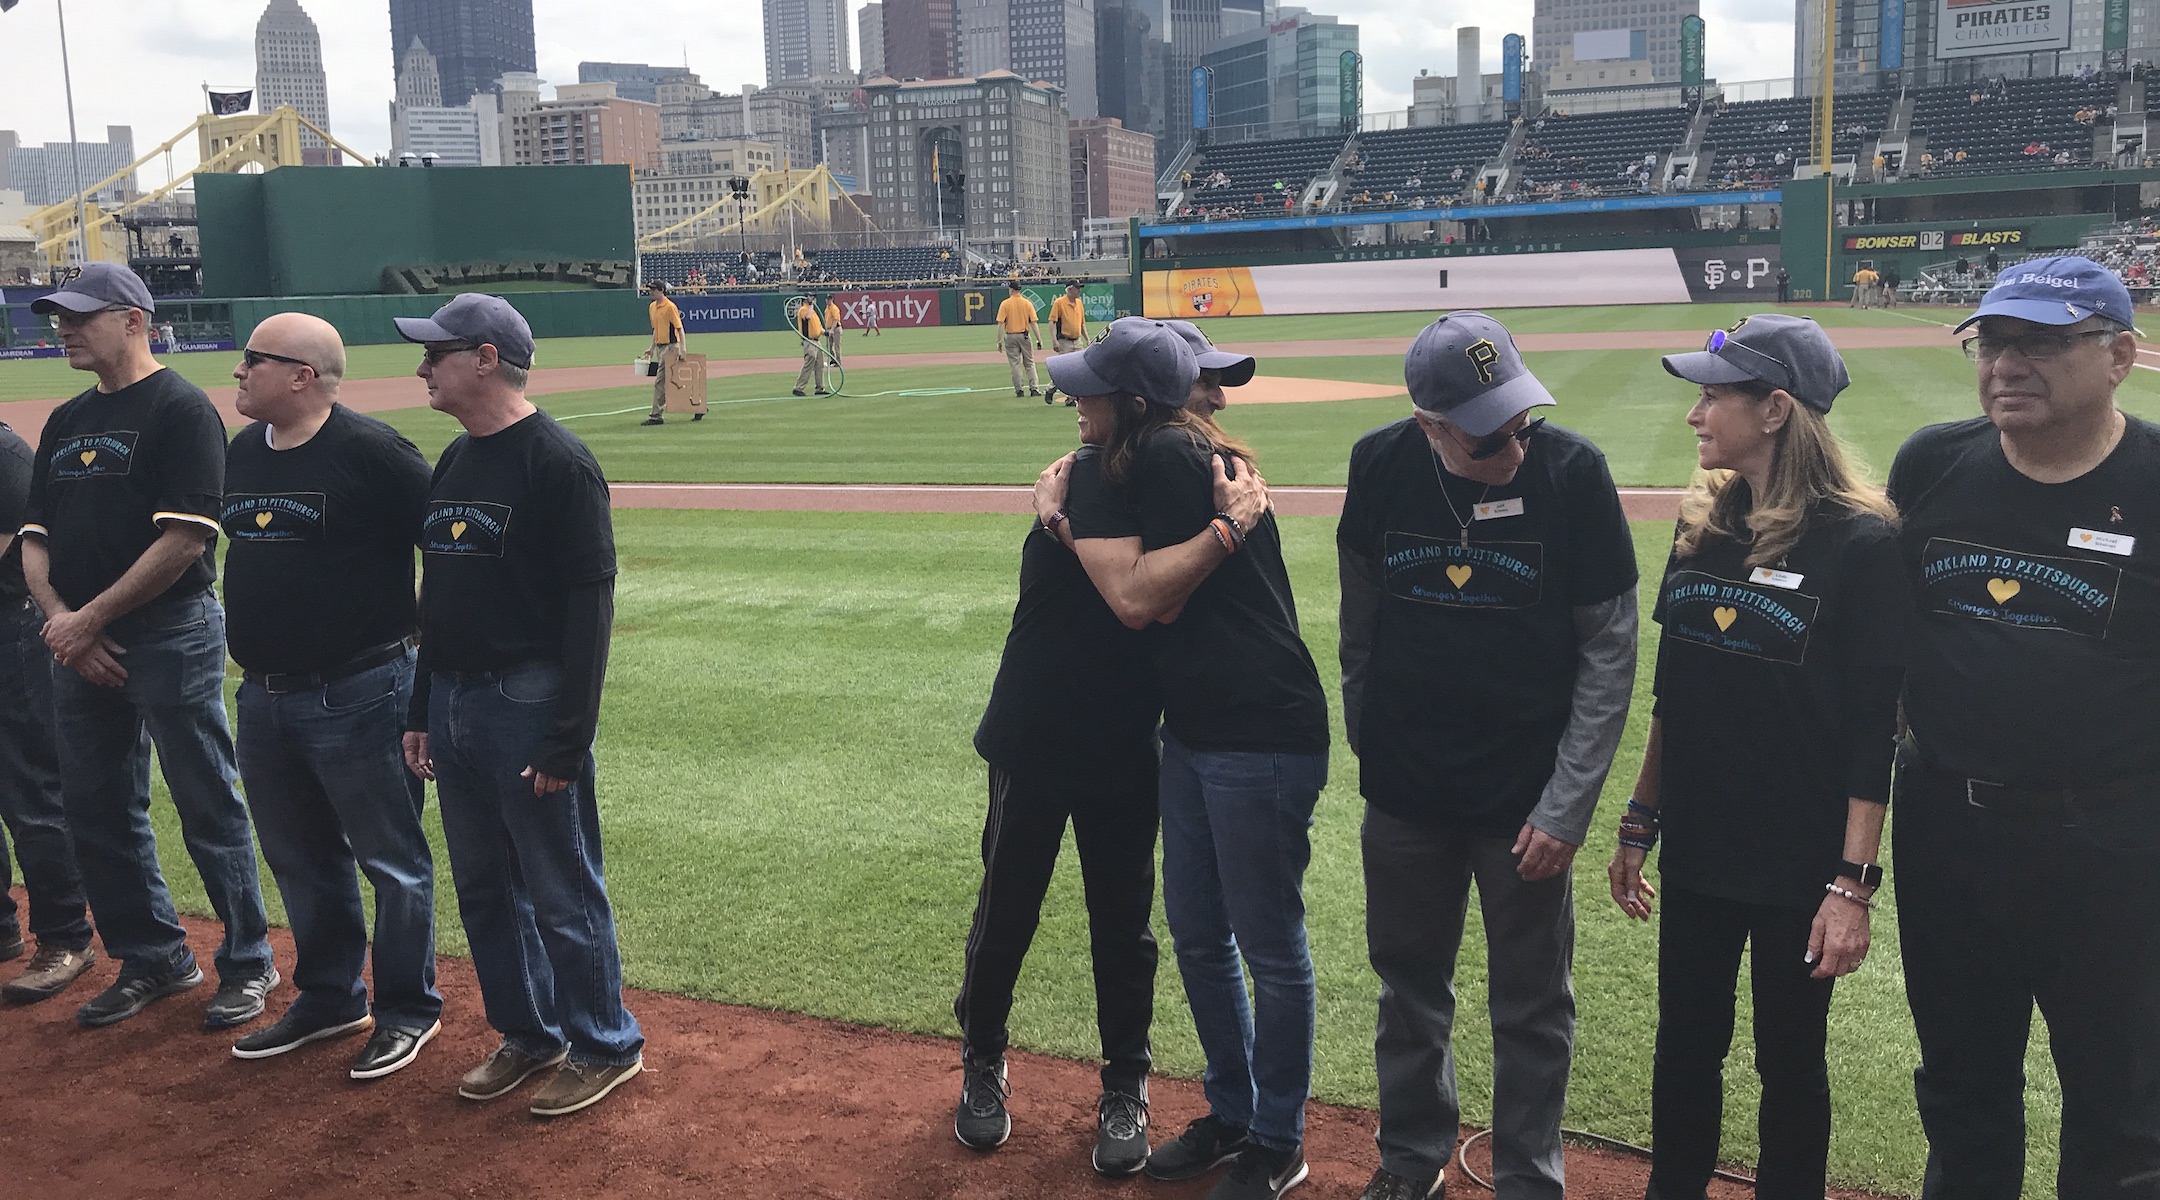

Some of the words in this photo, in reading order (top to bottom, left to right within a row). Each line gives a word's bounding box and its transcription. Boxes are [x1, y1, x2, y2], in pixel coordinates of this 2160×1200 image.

[1956, 5, 2050, 28] PIRATES
[1955, 23, 2050, 41] CHARITIES
[1687, 37, 1696, 60] AHN
[1344, 71, 1353, 92] AHN
[917, 99, 959, 107] RENAISSANCE
[1856, 235, 1916, 249] BOWSER
[1961, 231, 2021, 245] BLASTS
[1335, 250, 1416, 261] WELCOME
[1433, 248, 1450, 256] TO
[1466, 246, 1498, 255] PNC
[1515, 243, 1561, 252] PARK
[1746, 257, 1769, 289] P
[2020, 274, 2080, 289] Beigel
[1183, 277, 1218, 292] PIRATES
[963, 292, 985, 322] P
[1192, 293, 1212, 304] MLB
[689, 307, 755, 321] HYUNDAI
[843, 294, 932, 326] xfnity
[1084, 308, 1113, 316] etwork
[1116, 310, 1131, 318] 375
[181, 343, 218, 351] GUARDIAN
[1465, 338, 1501, 386] P
[84, 438, 93, 447] TO
[258, 498, 268, 507] TO
[269, 498, 320, 521] PITTSBURGH
[423, 507, 453, 531] PARKLAND
[456, 506, 464, 516] TO
[465, 506, 502, 535] PITTSBURGH
[1387, 545, 1442, 568] PARKLAND
[1447, 545, 1462, 558] TO
[1466, 547, 1539, 581] PITTSBURGH
[1924, 553, 1988, 579] PARKLAND
[1994, 556, 2012, 569] TO
[2016, 560, 2109, 608] PITTSBURGH
[1411, 585, 1454, 602] Stronger
[1667, 583, 1717, 603] PARKLAND
[1722, 586, 1731, 599] TO
[1735, 588, 1806, 635] PITTSBURGH
[1948, 598, 1999, 617] Stronger
[2001, 608, 2058, 625] Together
